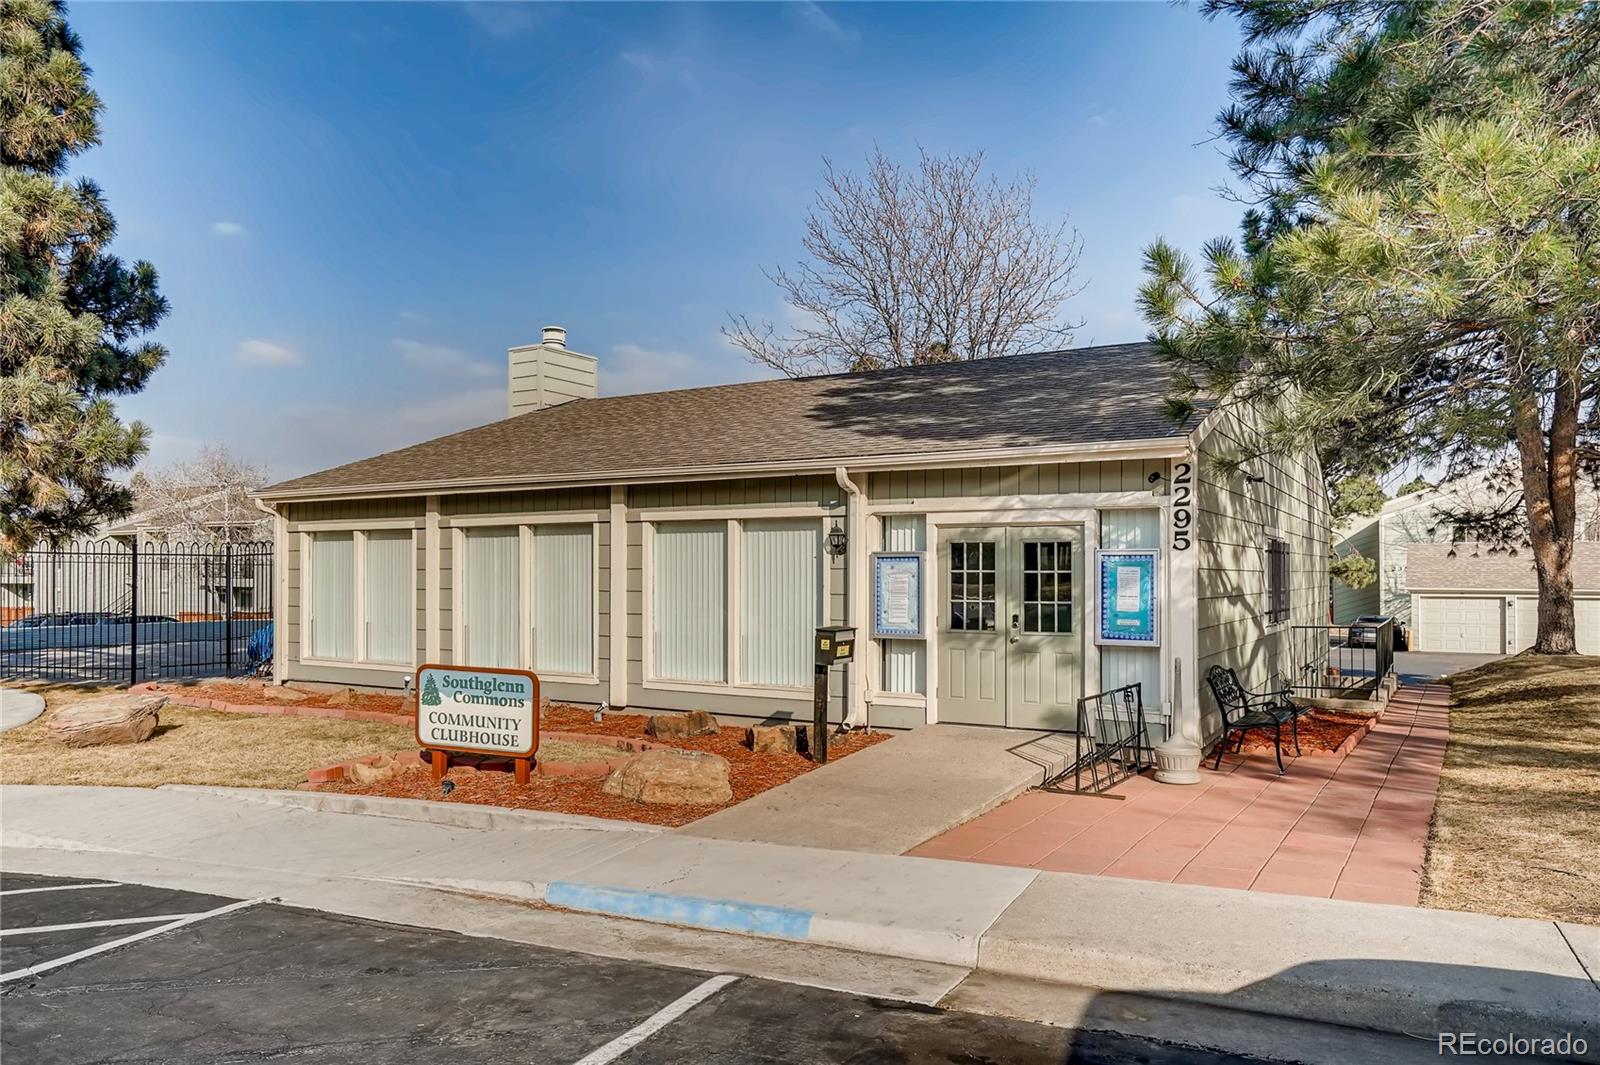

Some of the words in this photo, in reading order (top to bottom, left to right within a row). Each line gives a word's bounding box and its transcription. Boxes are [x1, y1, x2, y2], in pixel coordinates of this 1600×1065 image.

[1173, 463, 1191, 551] 2295
[442, 675, 525, 695] Southglenn
[453, 690, 525, 708] Commons
[428, 711, 522, 731] COMMUNITY
[431, 727, 519, 747] CLUBHOUSE
